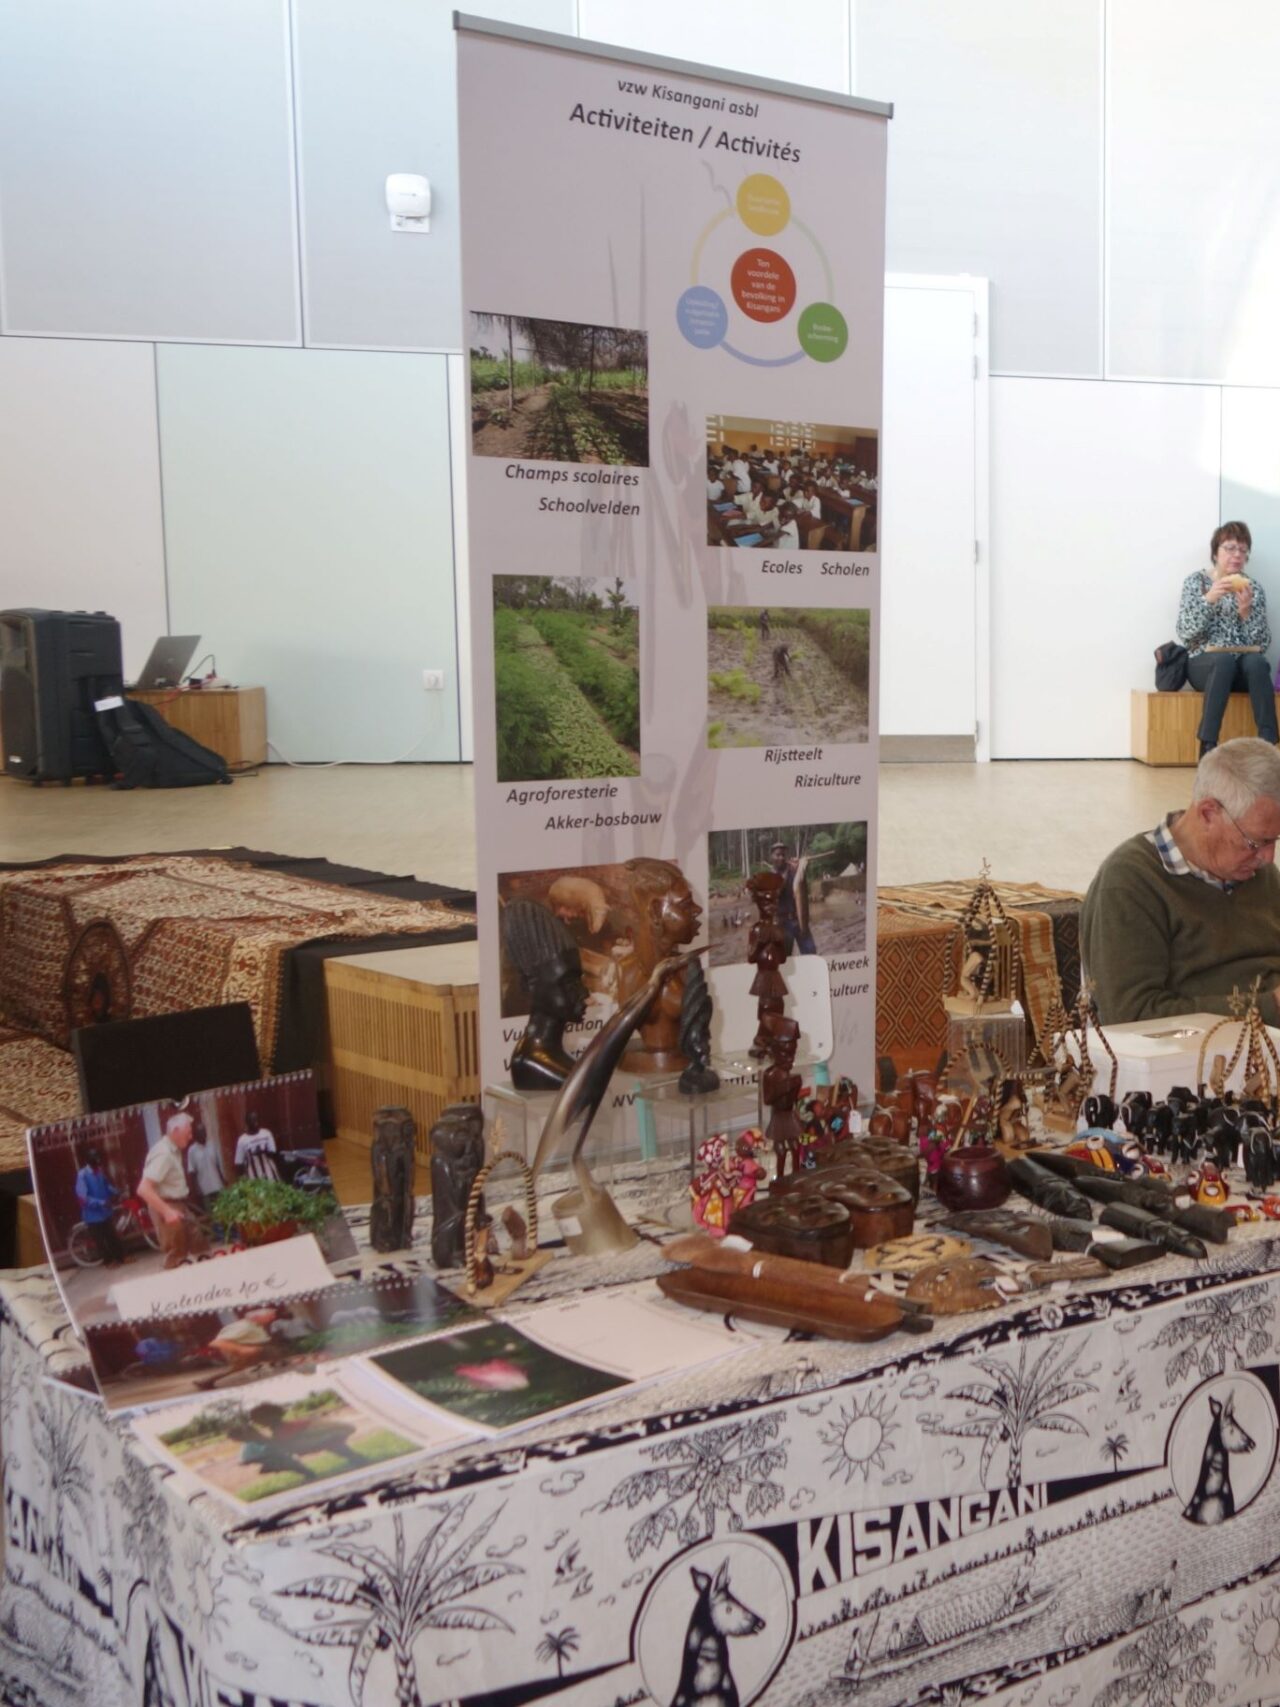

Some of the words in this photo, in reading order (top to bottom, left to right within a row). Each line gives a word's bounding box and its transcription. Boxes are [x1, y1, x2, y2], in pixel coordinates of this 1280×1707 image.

[618, 80, 648, 96] vzw
[652, 84, 726, 110] Kisangani
[729, 102, 759, 118] asbl
[569, 103, 694, 143] Activiteiten
[698, 126, 712, 149] /
[715, 131, 801, 163] Activités
[505, 463, 570, 485] Champs
[572, 468, 640, 487] scolaires
[538, 496, 641, 517] Schoolvelden
[761, 560, 803, 576] Ecoles
[820, 562, 870, 577] Scholen
[764, 746, 824, 765] Rijstteelt
[794, 772, 862, 789] Riziculture
[506, 784, 618, 805] Agroforesterie
[545, 809, 663, 832] Akker-bosbouw
[797, 1482, 1048, 1599] KISANGANI
